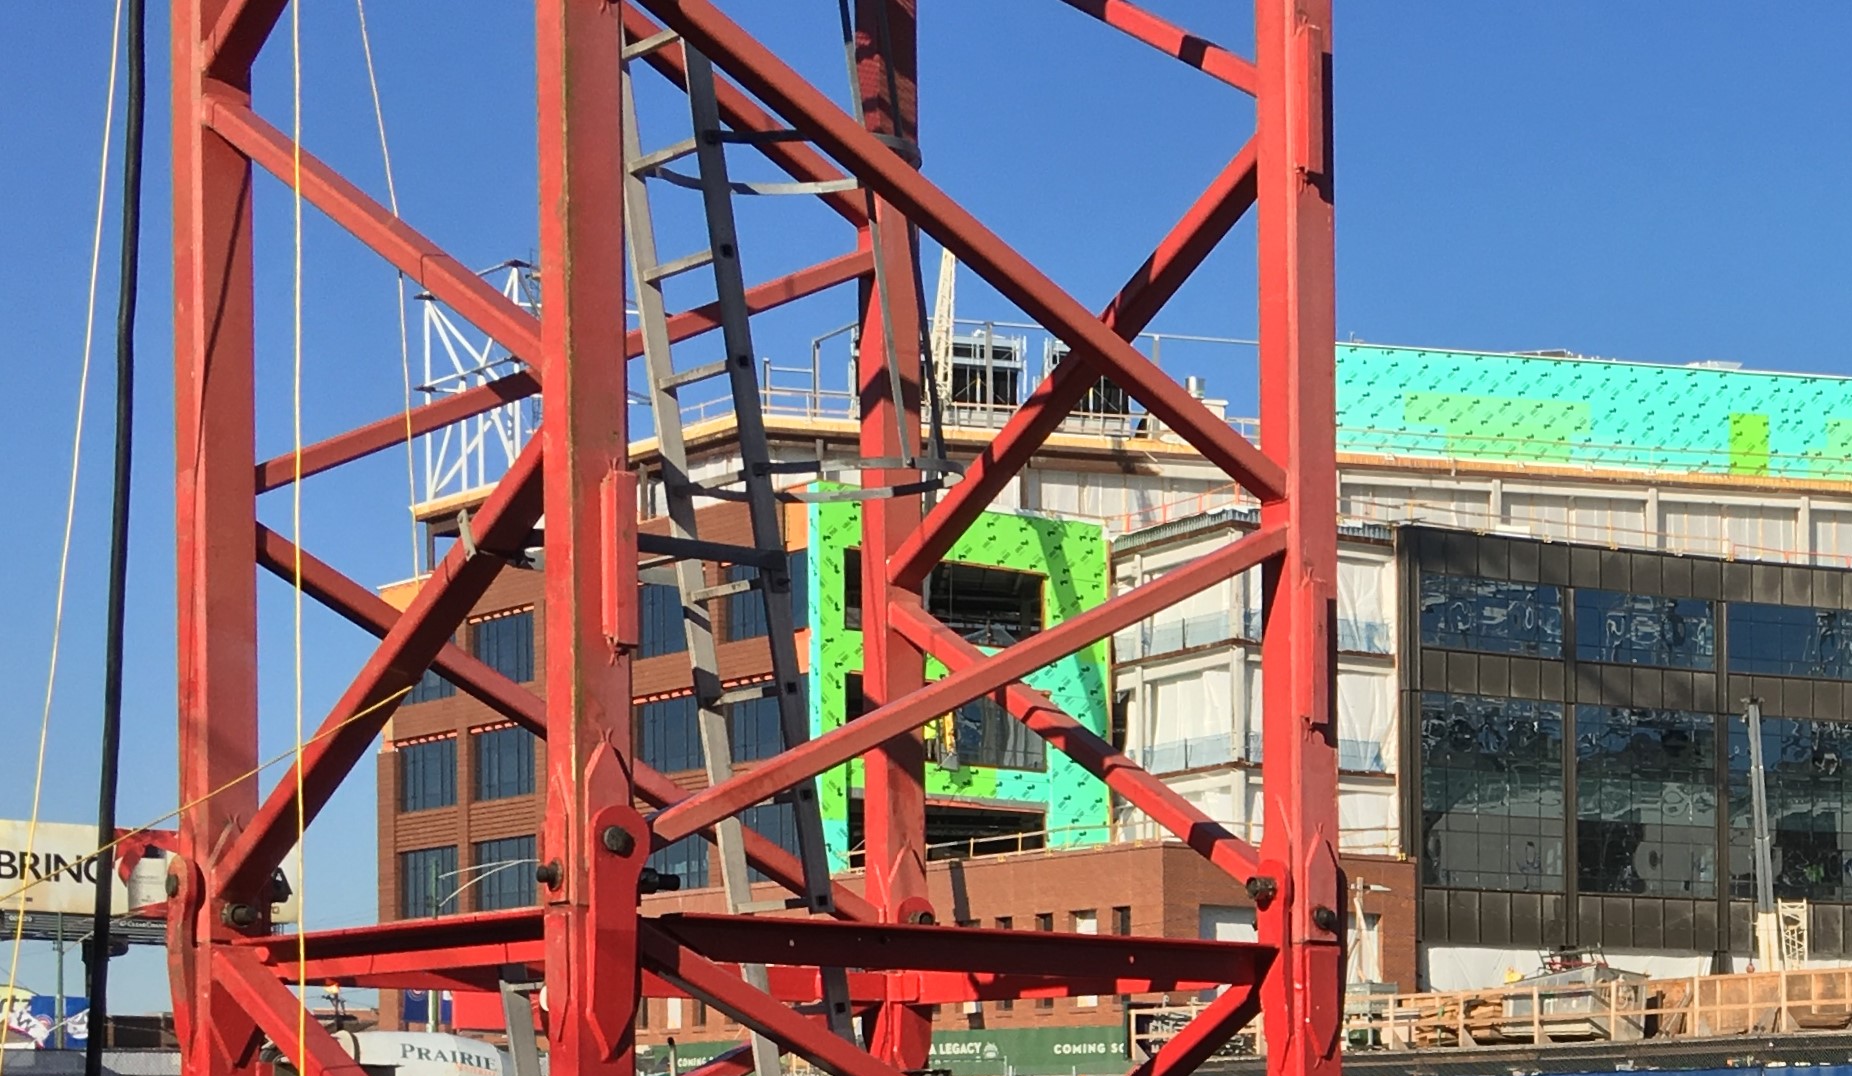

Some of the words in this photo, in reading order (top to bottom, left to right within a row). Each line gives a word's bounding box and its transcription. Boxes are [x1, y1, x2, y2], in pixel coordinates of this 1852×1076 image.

[939, 1042, 982, 1055] LEGACY
[1053, 1043, 1106, 1055] COMING
[400, 1043, 498, 1072] PRAIRIE
